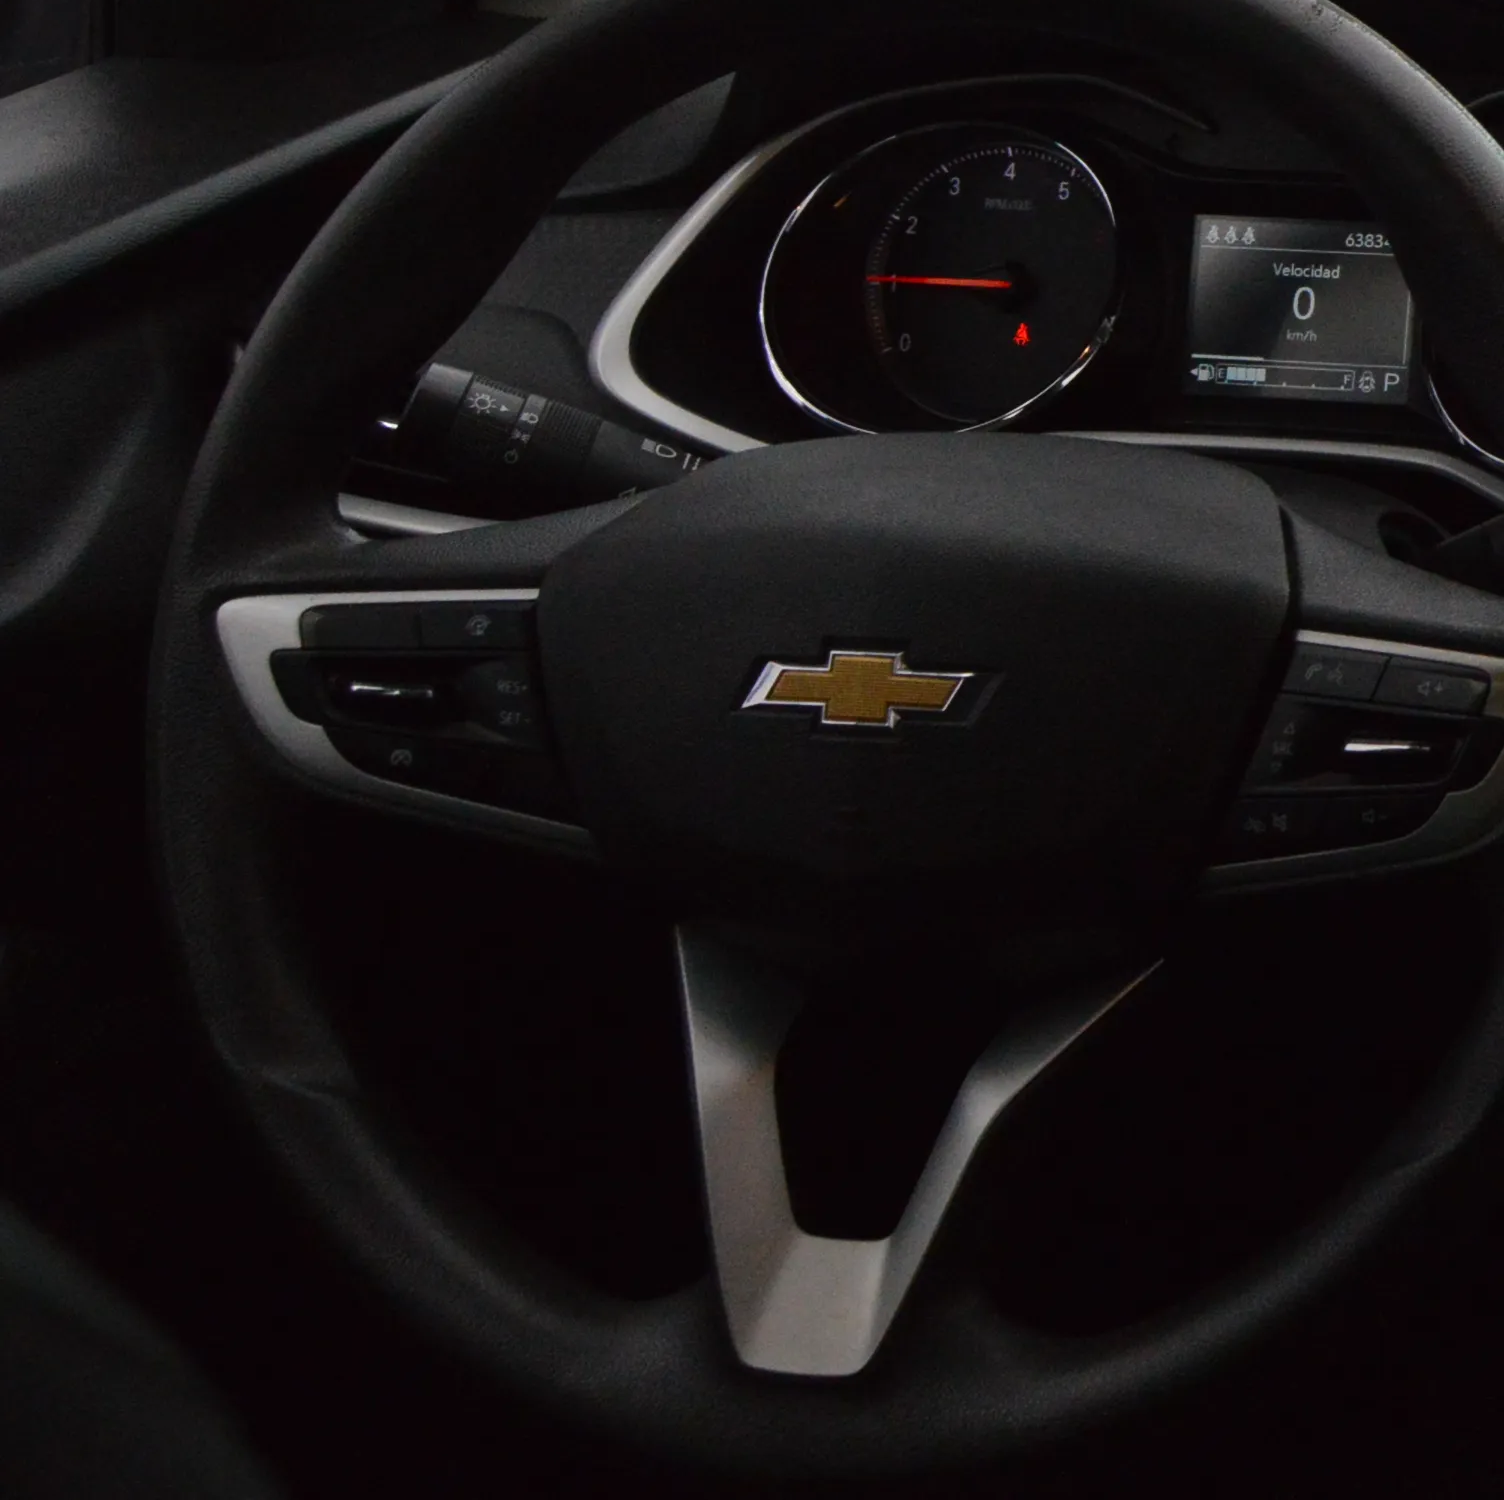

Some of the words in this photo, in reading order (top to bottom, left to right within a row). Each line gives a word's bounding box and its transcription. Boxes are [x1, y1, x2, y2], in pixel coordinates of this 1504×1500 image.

[1003, 160, 1018, 181] 4
[947, 177, 962, 196] 3
[1056, 181, 1071, 201] 5
[905, 215, 920, 236] 2
[1273, 262, 1341, 280] Velocidad
[1292, 286, 1316, 320] 0
[899, 333, 912, 352] 0
[1286, 329, 1318, 342] km/h
[1384, 372, 1401, 392] P
